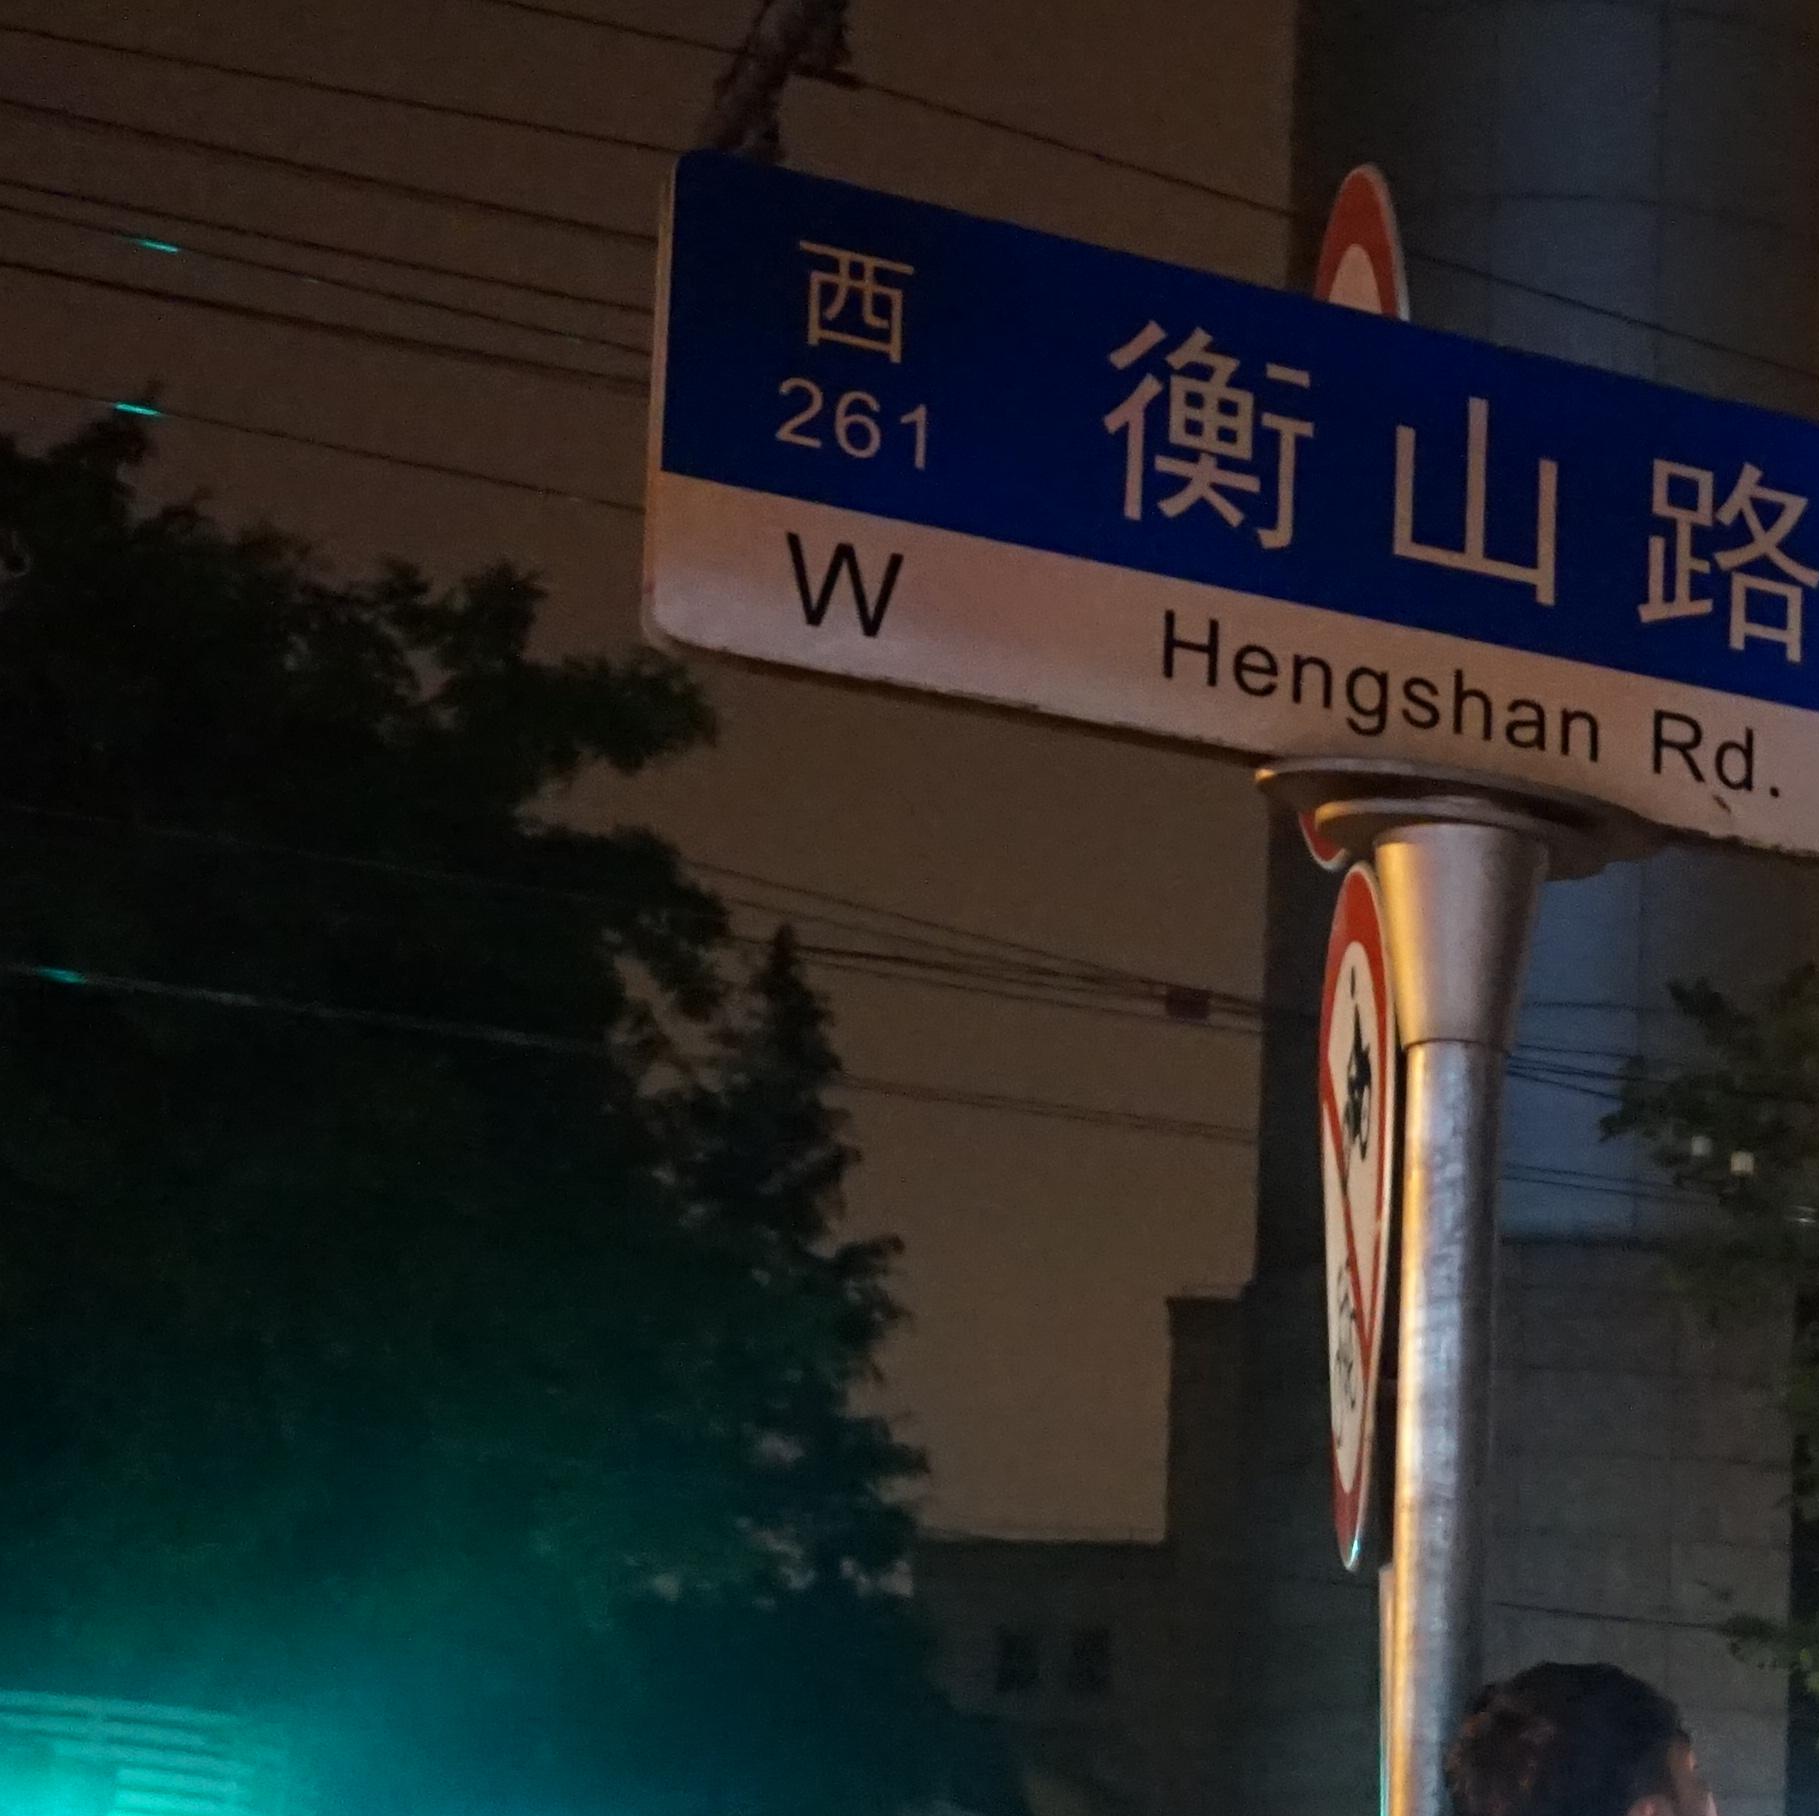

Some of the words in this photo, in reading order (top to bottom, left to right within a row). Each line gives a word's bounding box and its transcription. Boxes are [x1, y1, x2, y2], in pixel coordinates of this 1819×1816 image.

[799, 240, 914, 364] 西
[776, 377, 929, 470] 261
[787, 532, 904, 638] W
[1163, 608, 1601, 763] Hengshan
[1652, 709, 1781, 798] Rd.
